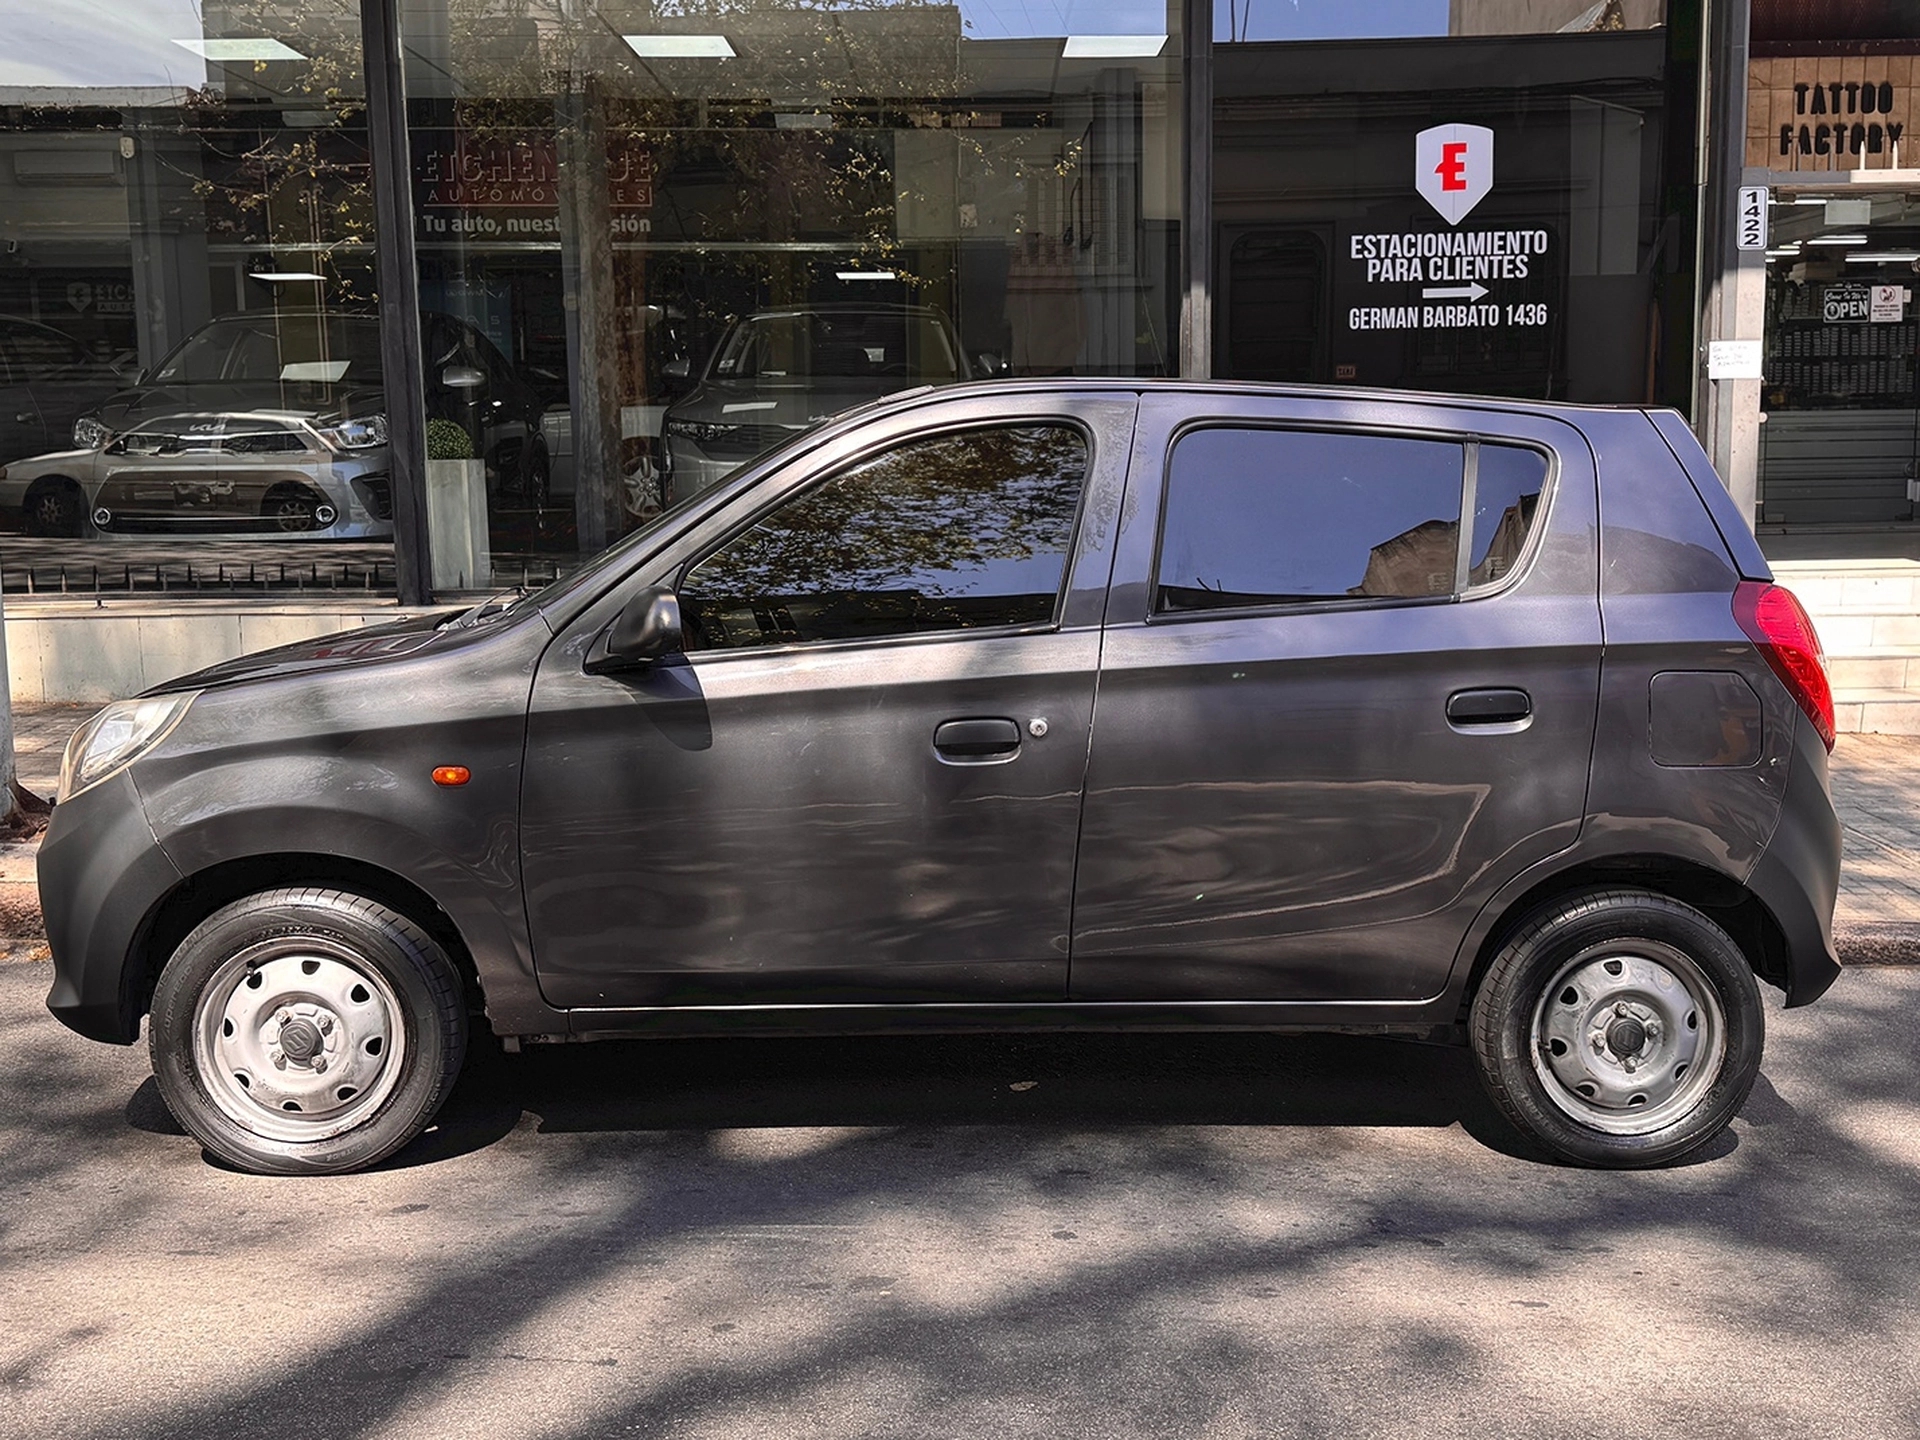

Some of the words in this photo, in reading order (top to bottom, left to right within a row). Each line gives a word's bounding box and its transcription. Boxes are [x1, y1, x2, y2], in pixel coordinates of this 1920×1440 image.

[1795, 82, 1893, 115] TATTOO
[1780, 122, 1903, 155] FACTORY
[423, 215, 446, 232] Tu
[451, 215, 502, 236] auto,
[506, 215, 561, 232] nuest
[610, 214, 651, 232] sión
[1744, 191, 1760, 246] 1422
[1351, 230, 1548, 259] ESTACIONAMIENTO
[1367, 258, 1423, 283] PARA
[1428, 254, 1529, 281] CLIENTES
[1349, 307, 1418, 330] GERMAN
[1423, 305, 1500, 328] BARBATO
[1506, 304, 1548, 326] 1436
[1824, 300, 1868, 320] OPEN
